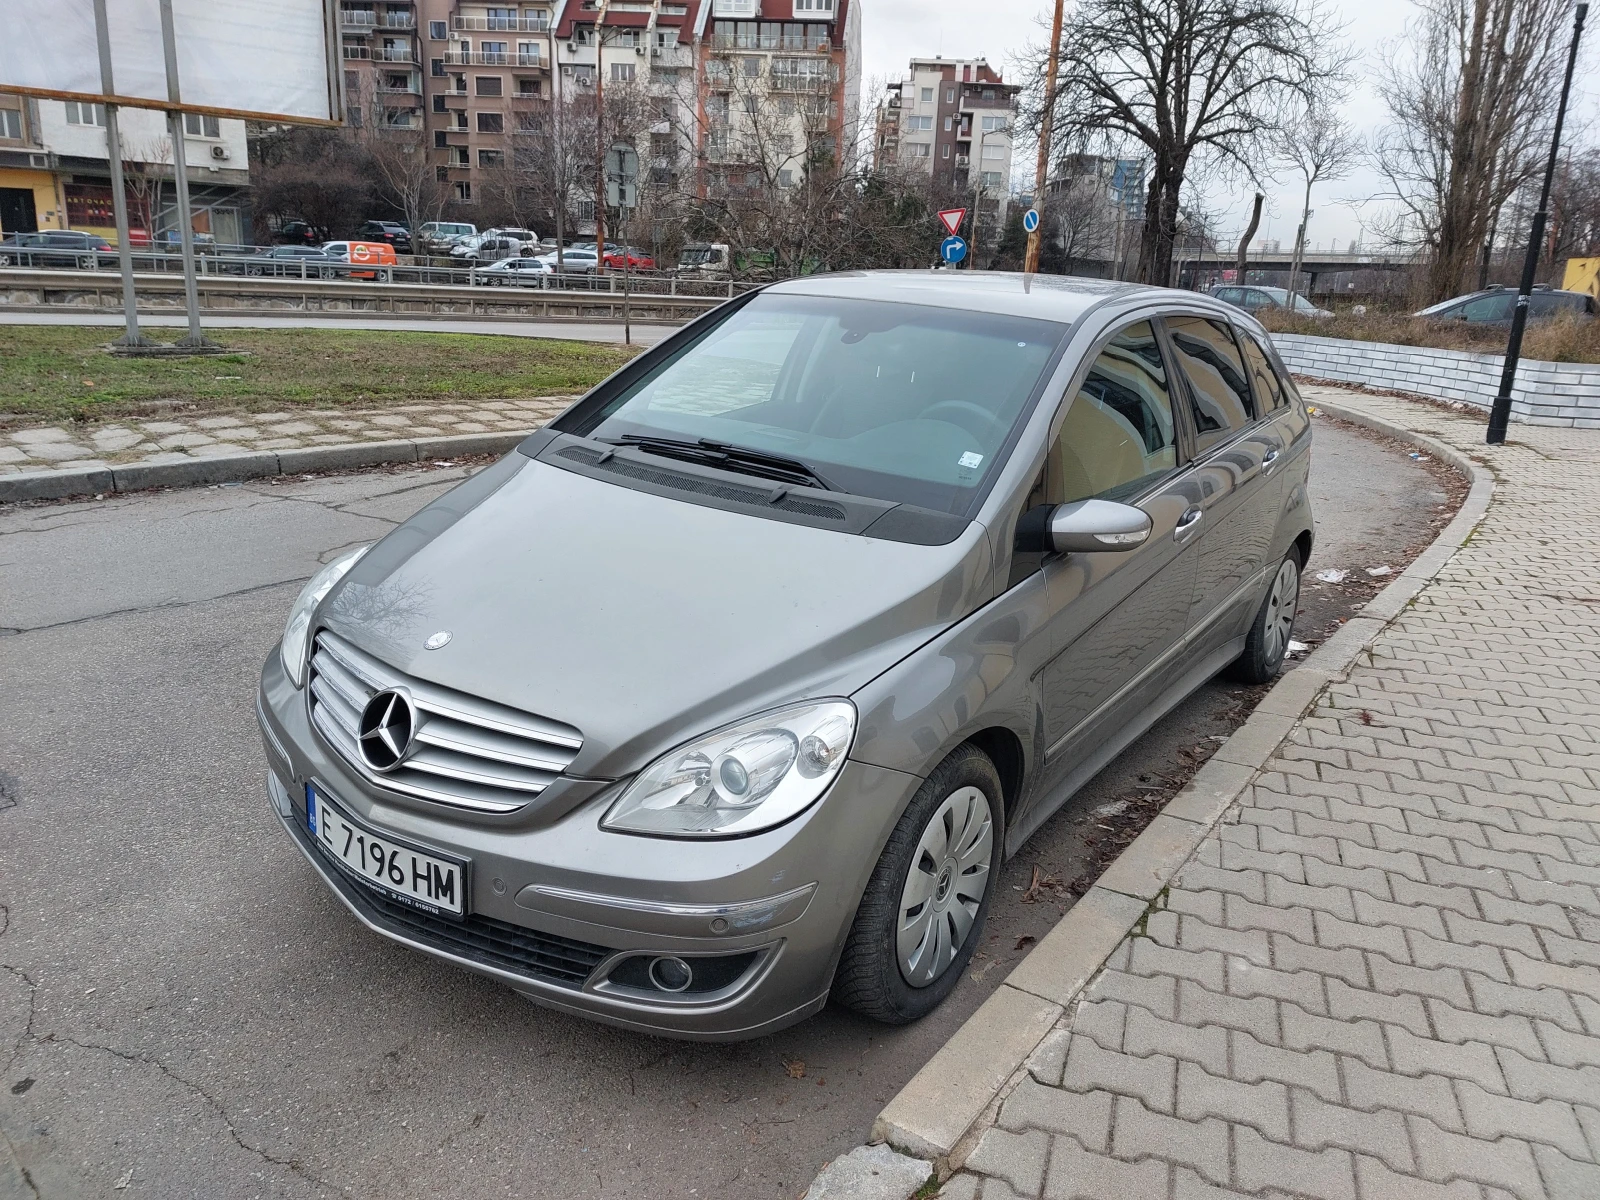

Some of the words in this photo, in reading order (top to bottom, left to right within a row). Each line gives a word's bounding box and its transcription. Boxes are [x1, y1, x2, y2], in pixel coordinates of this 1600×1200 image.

[322, 805, 333, 845] E
[341, 822, 405, 886] 7196
[411, 856, 455, 906] HM
